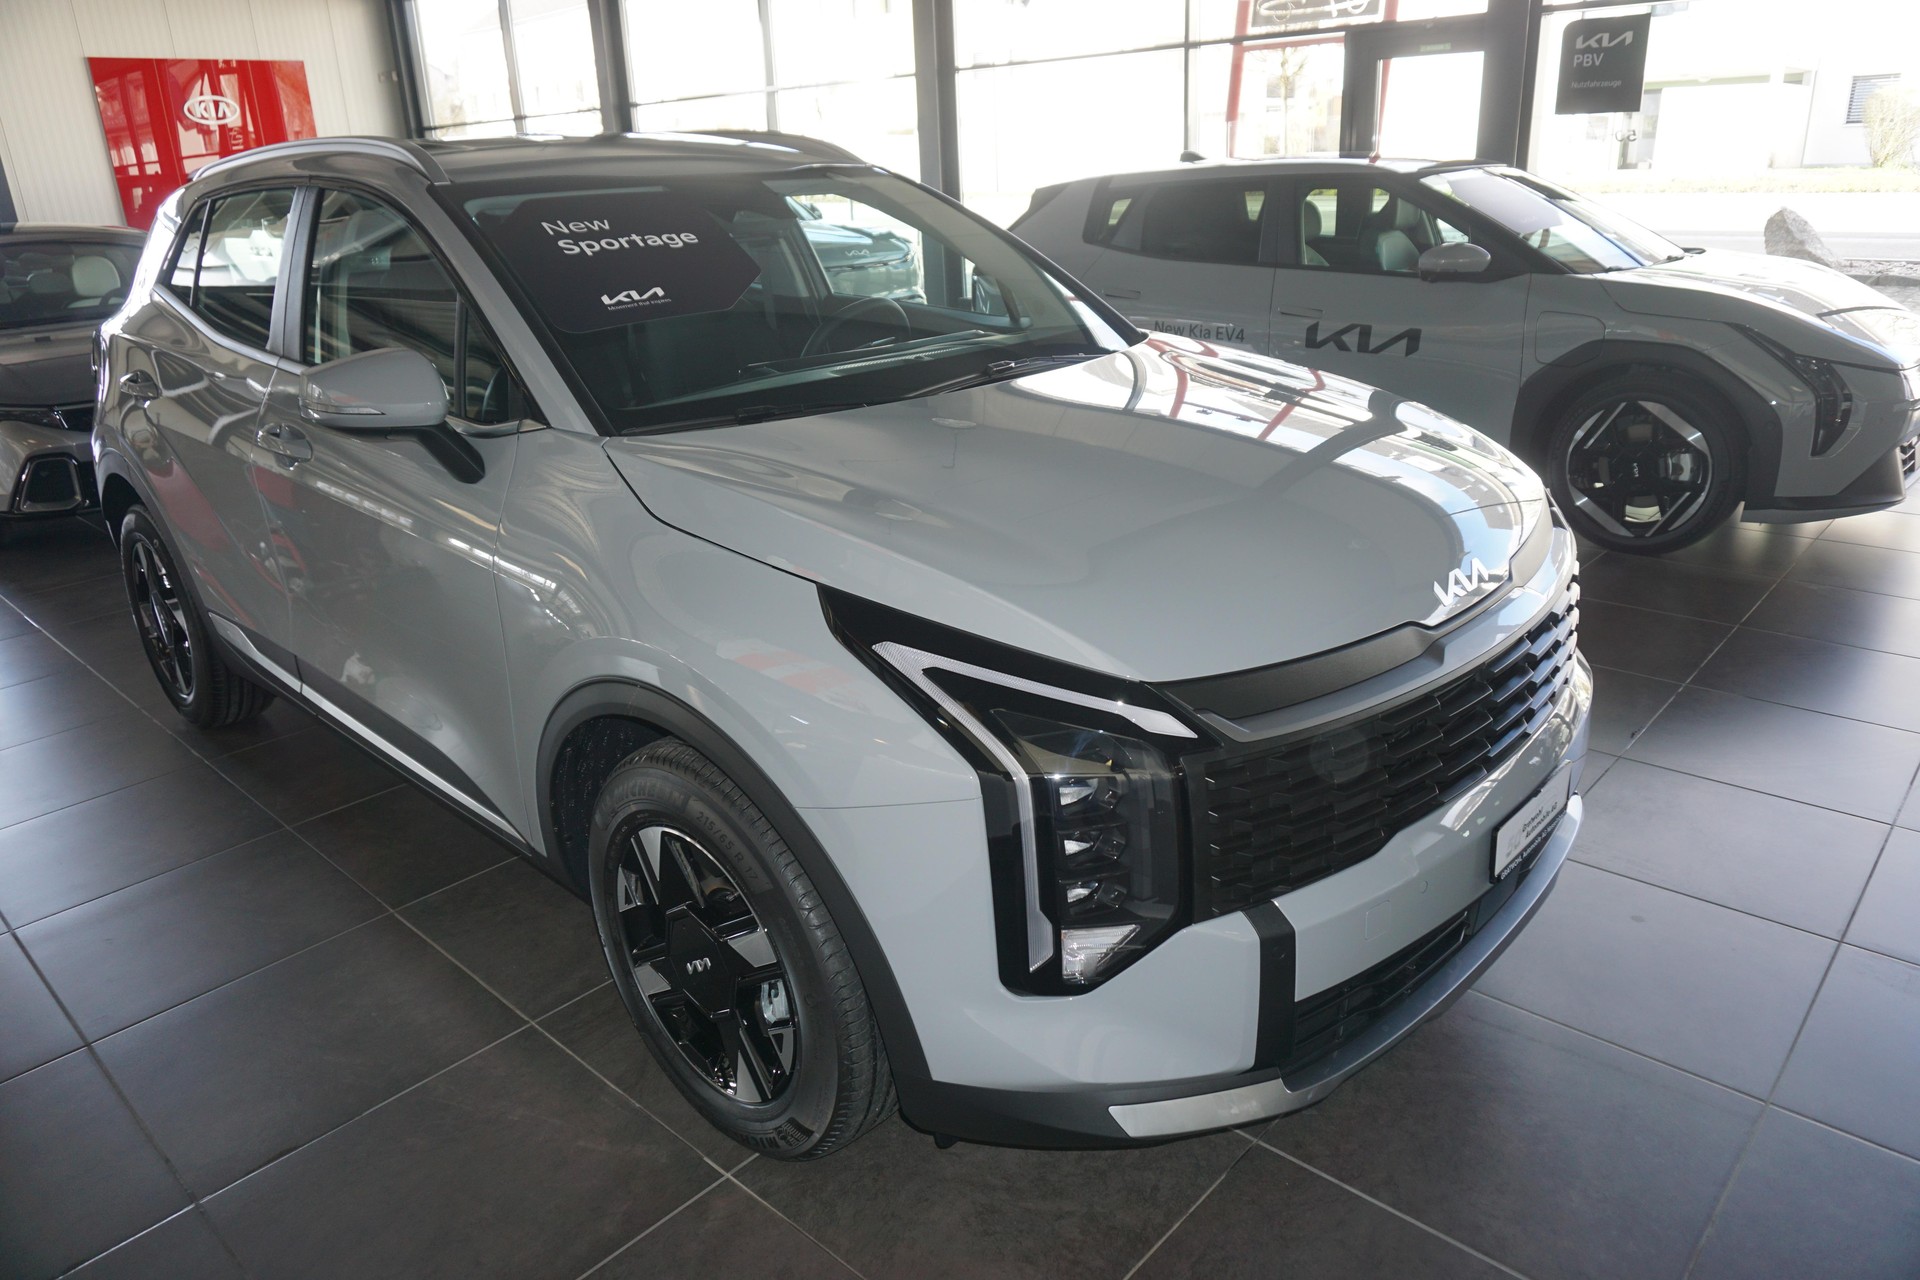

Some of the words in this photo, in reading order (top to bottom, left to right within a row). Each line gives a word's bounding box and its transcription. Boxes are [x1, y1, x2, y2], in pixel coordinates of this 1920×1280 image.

[1576, 31, 1634, 49] KIA
[1573, 53, 1605, 68] PBV
[1570, 80, 1622, 89] Nutzfahrzeuge
[193, 101, 233, 118] KIA
[541, 219, 611, 236] New
[557, 232, 699, 256] Sportage
[601, 286, 665, 305] KIA
[1154, 320, 1185, 338] New
[1189, 323, 1212, 340] Kia
[1216, 326, 1245, 343] EV4
[1305, 321, 1422, 357] KIA
[1433, 557, 1489, 607] KIA
[695, 811, 735, 851] 215/65
[733, 851, 745, 864] R
